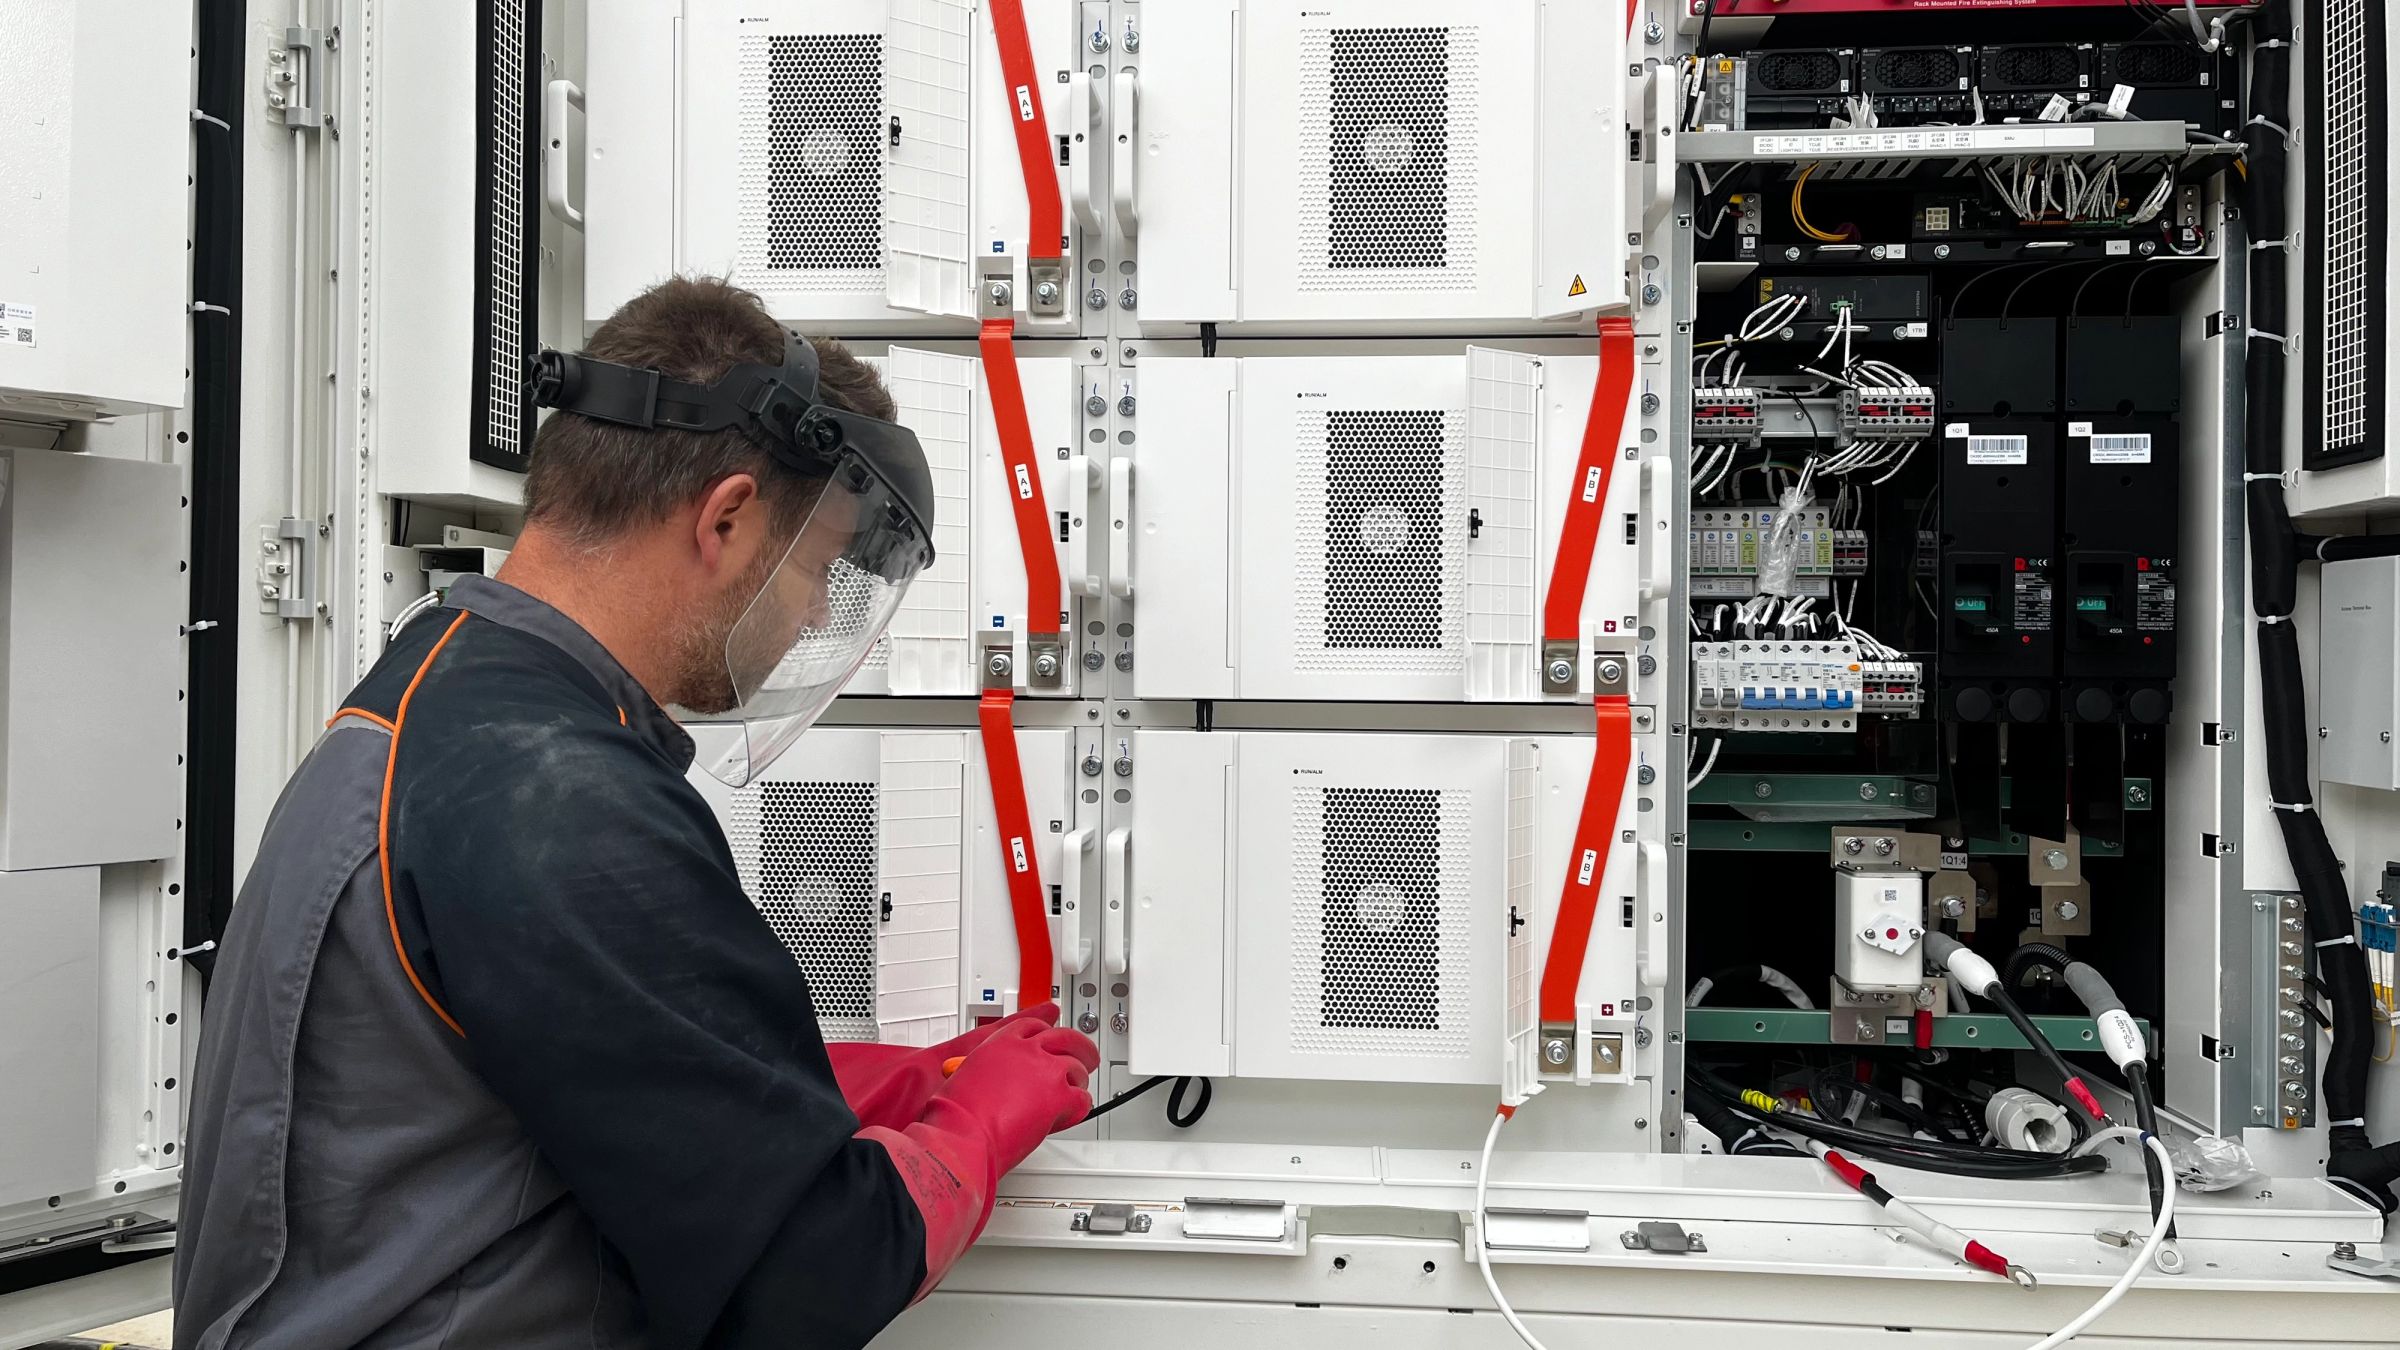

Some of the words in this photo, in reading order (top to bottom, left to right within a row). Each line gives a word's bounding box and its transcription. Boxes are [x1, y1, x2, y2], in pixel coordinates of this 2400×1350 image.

[1022, 99, 1029, 107] A
[1020, 478, 1028, 486] A
[1588, 480, 1595, 489] B
[1016, 851, 1023, 859] A
[1942, 856, 1967, 866] 1Q1:4
[1583, 863, 1591, 872] B
